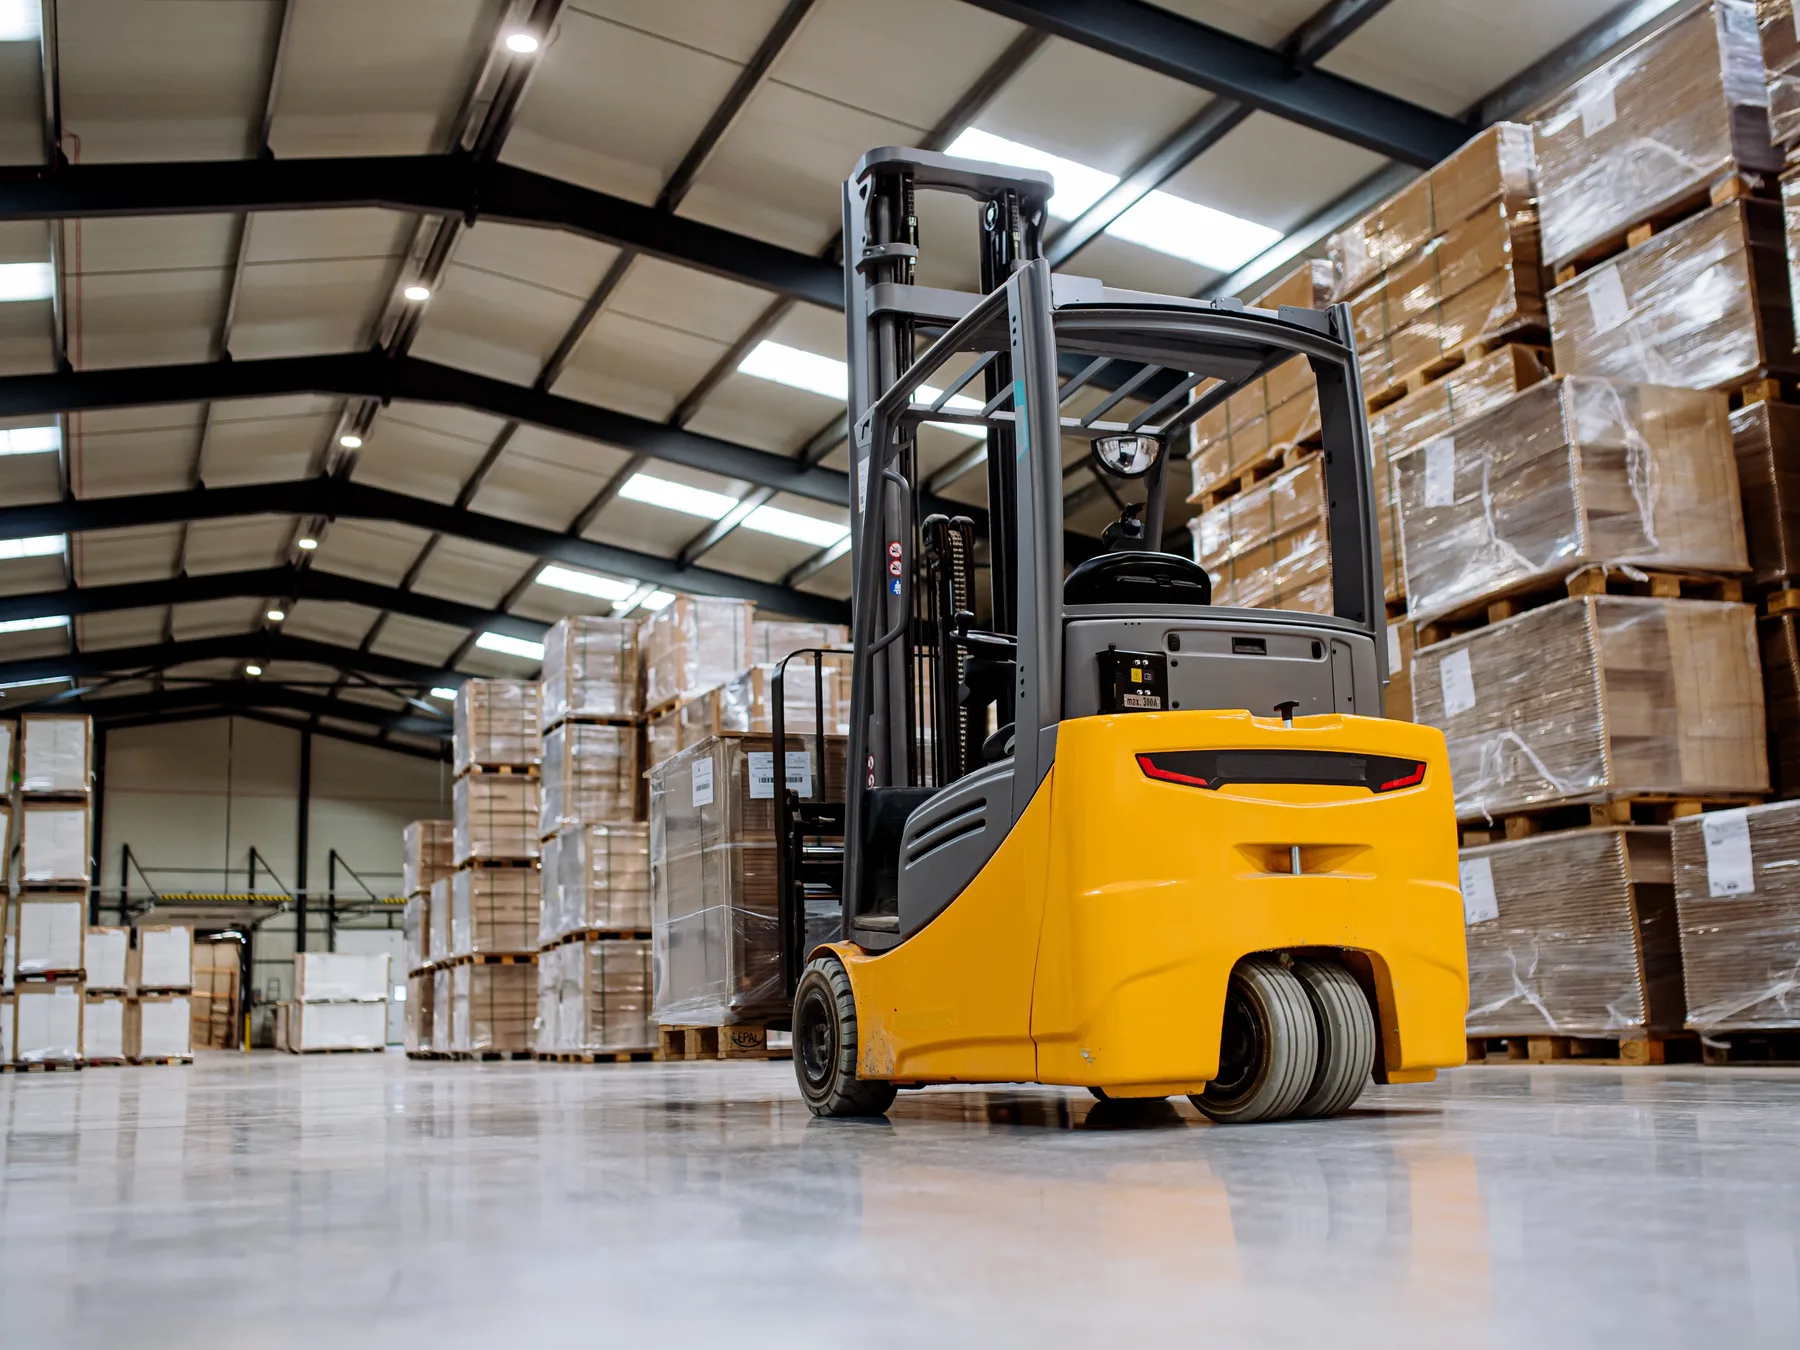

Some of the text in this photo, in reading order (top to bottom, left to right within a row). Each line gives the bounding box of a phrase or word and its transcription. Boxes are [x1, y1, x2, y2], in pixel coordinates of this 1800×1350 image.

[1127, 697, 1158, 707] max. 300A
[738, 1032, 758, 1043] EPAL
